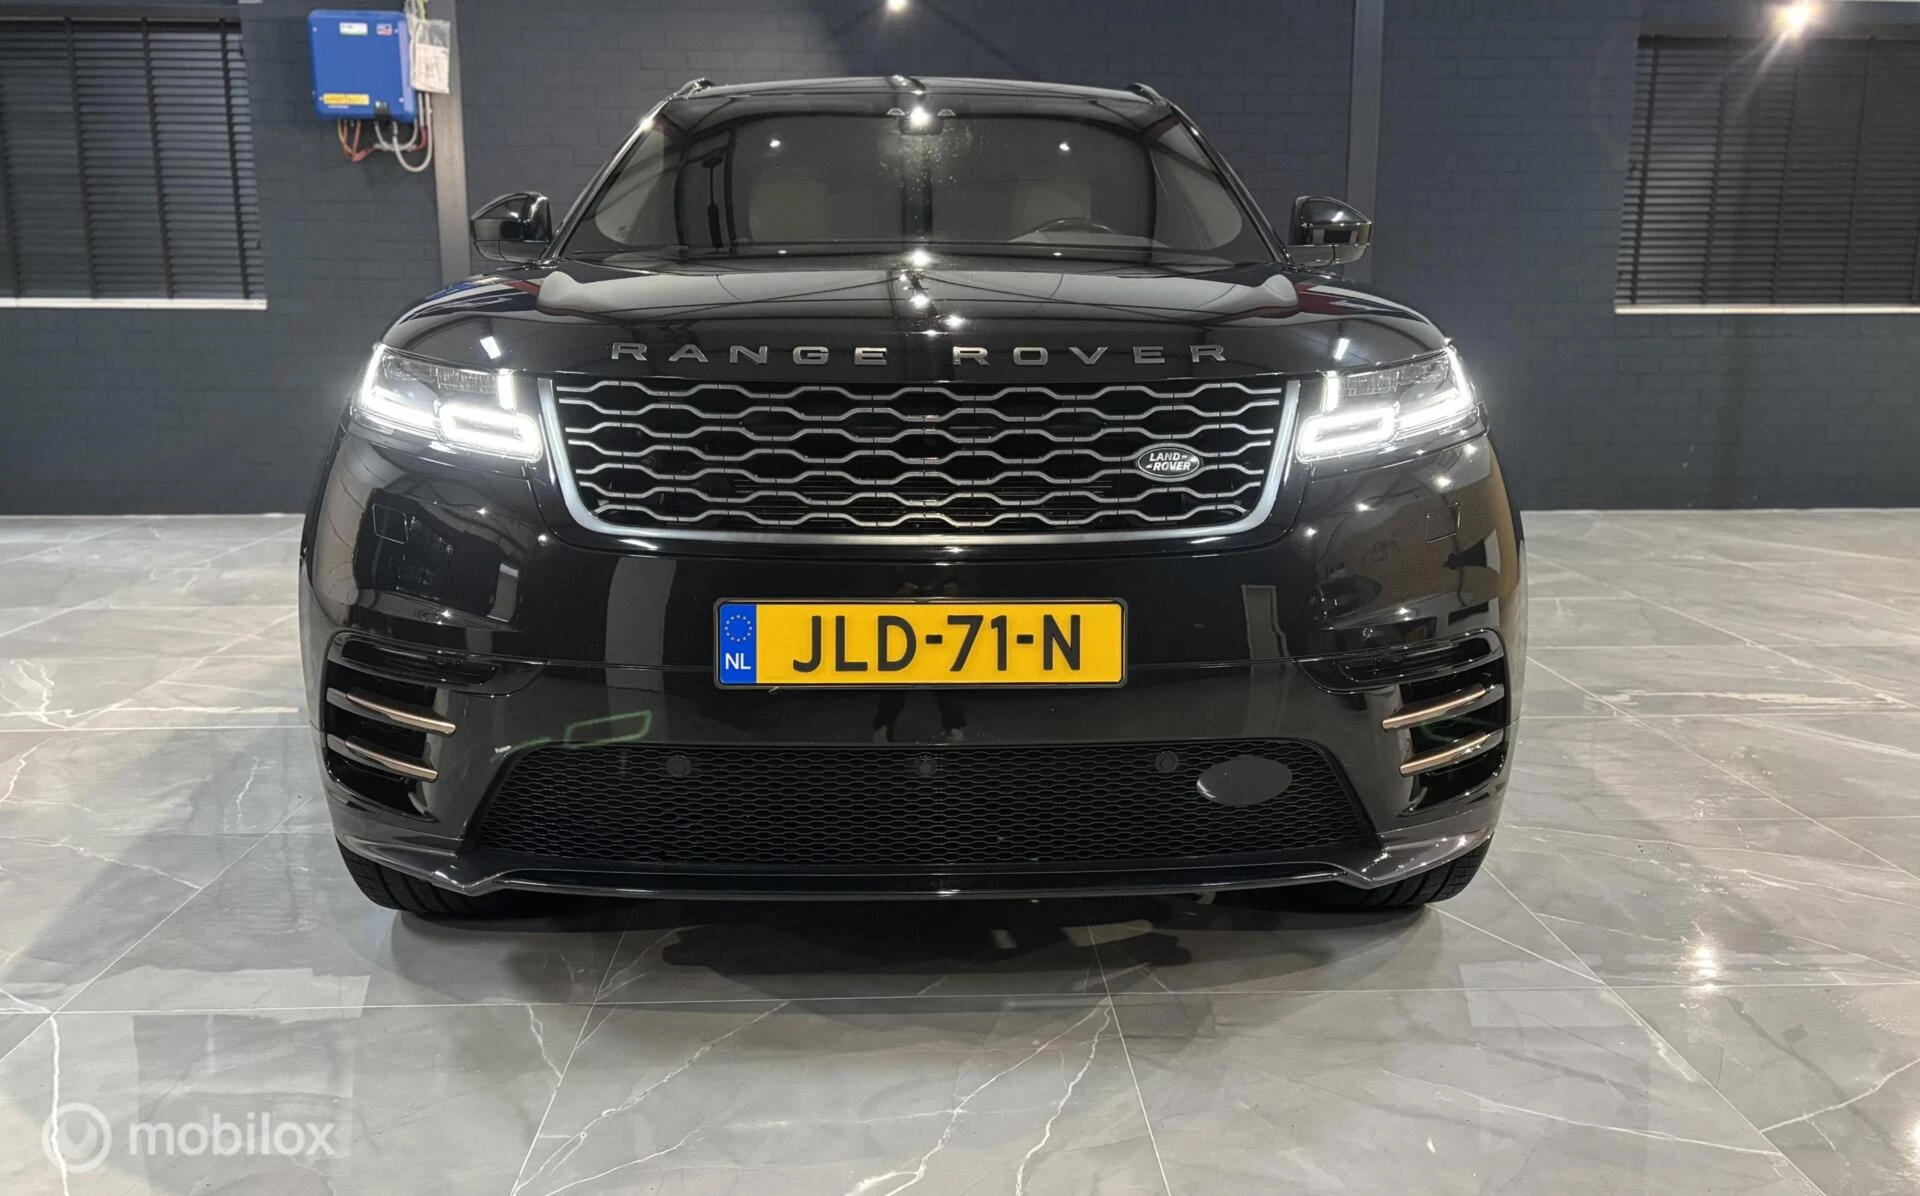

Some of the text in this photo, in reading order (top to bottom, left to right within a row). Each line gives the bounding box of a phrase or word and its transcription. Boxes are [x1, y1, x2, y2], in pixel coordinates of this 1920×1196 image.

[611, 342, 1227, 366] RANGE ROVER
[792, 614, 1081, 673] JLD-71-N
[724, 653, 752, 671] NL
